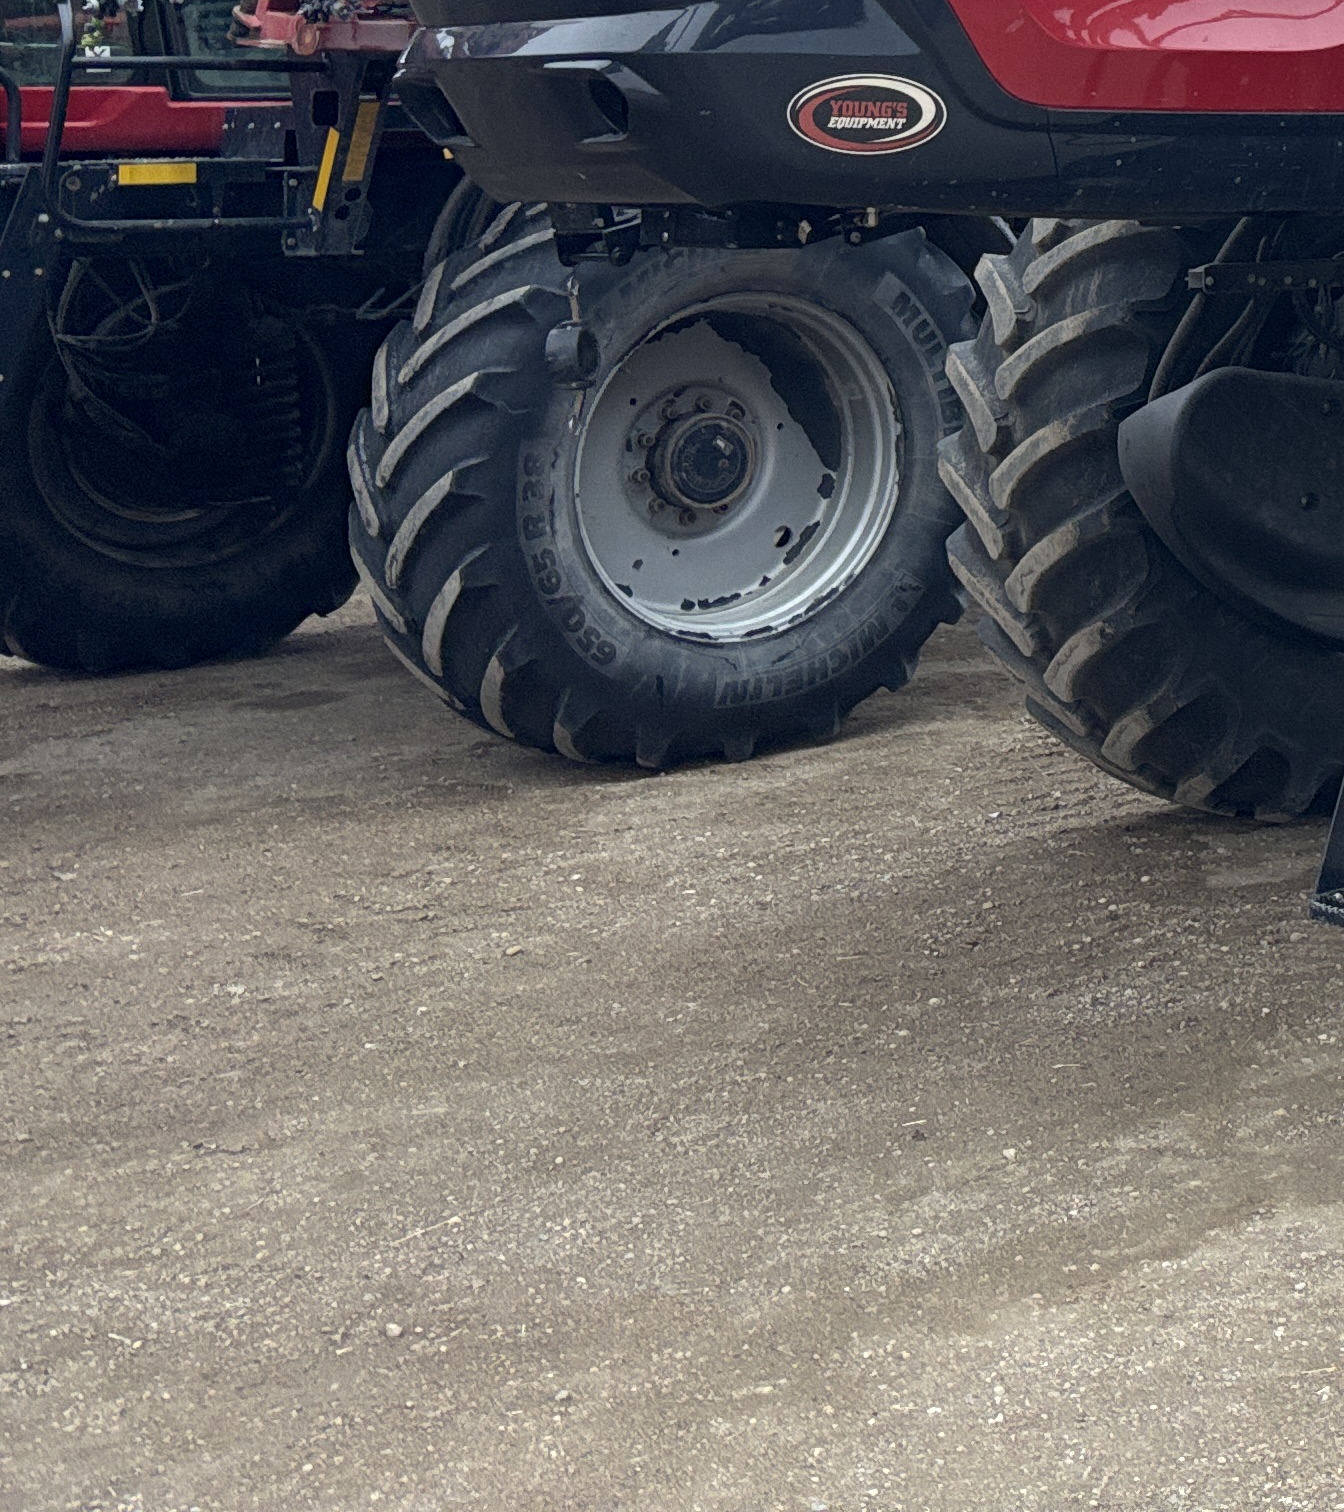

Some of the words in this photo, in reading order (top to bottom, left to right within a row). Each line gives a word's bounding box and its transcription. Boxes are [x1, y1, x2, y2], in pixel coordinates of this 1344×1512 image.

[830, 100, 908, 117] YOUNG'S
[827, 116, 907, 129] EQUIPMENT
[718, 618, 891, 705] MICHELIN
